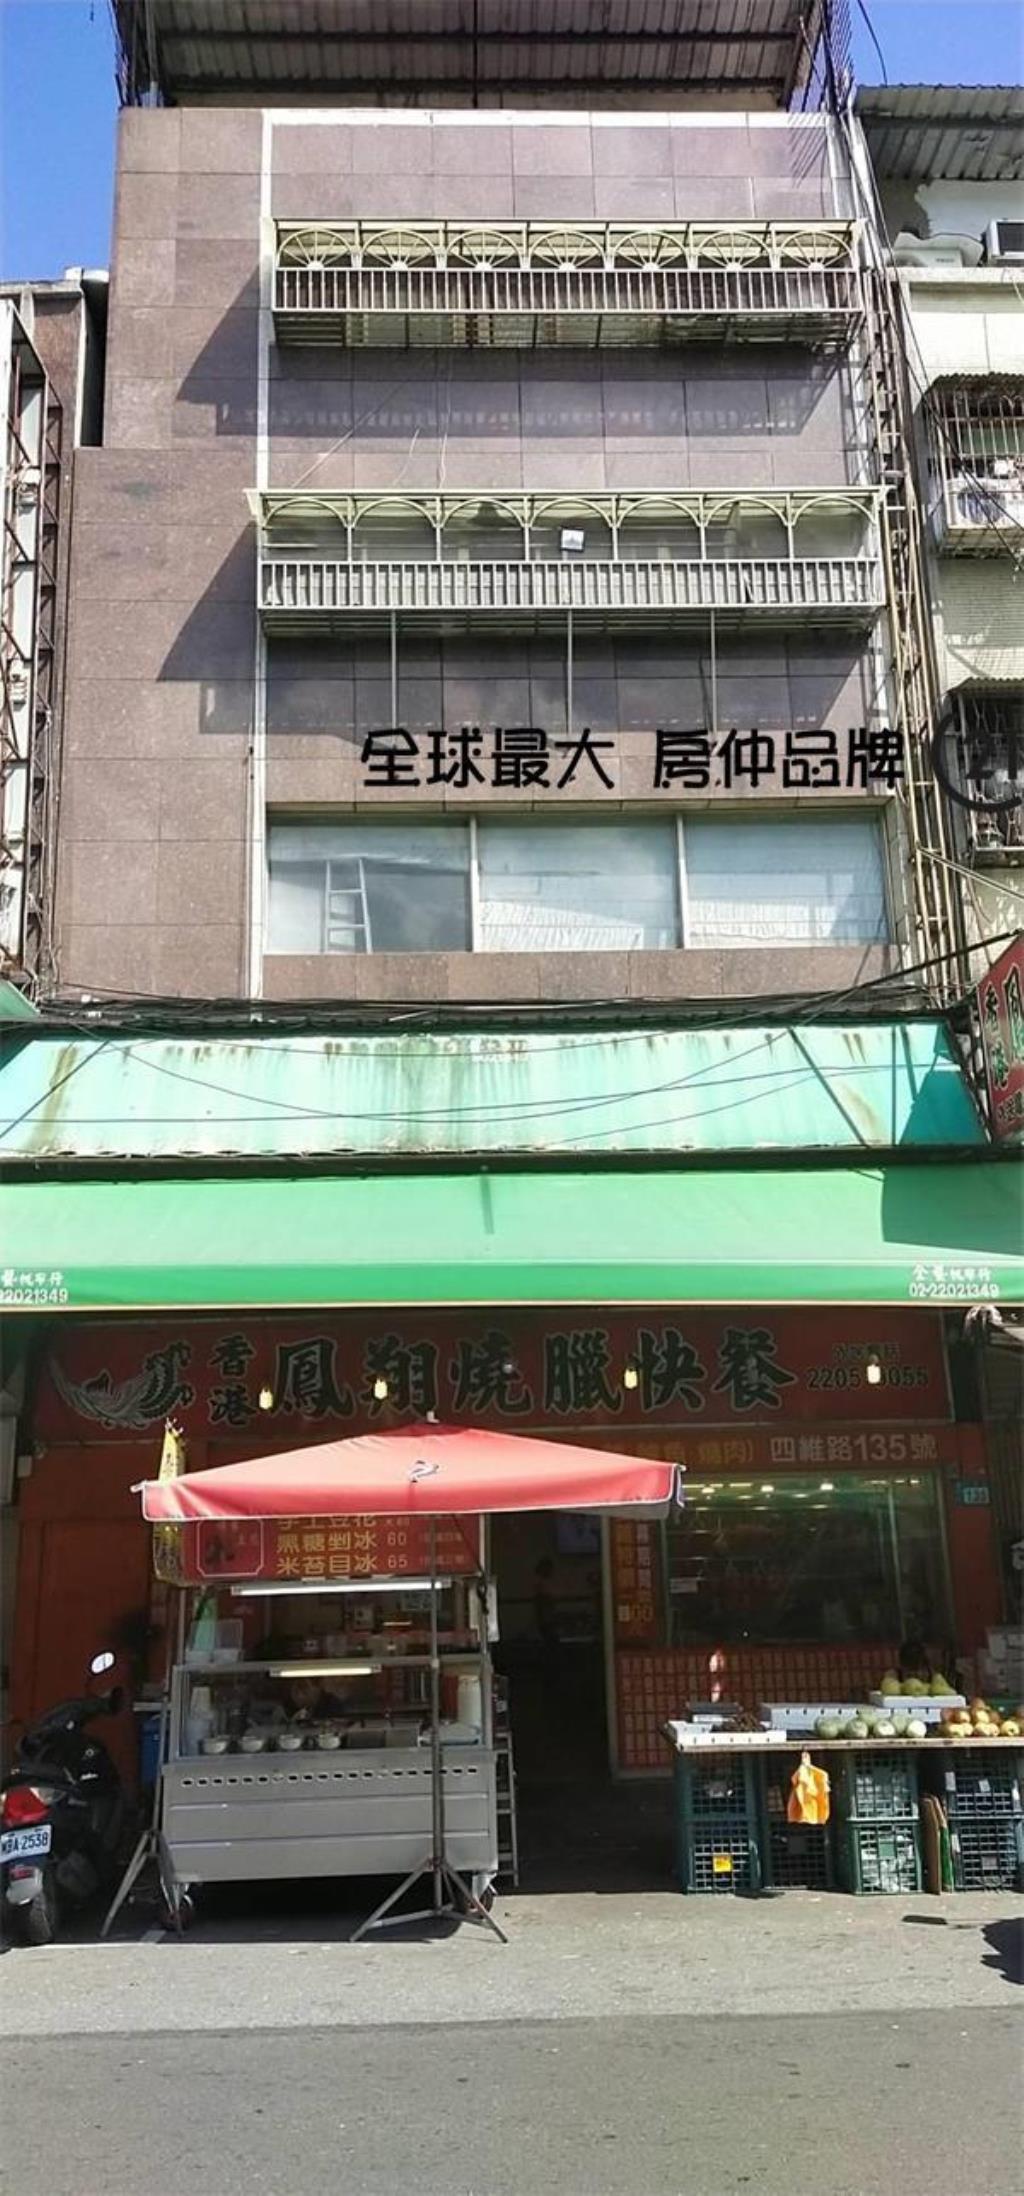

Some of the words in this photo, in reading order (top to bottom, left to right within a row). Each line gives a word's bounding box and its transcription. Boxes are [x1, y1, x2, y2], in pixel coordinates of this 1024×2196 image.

[908, 1283, 999, 1298] 02-22021349
[209, 1332, 257, 1426] 香港
[276, 1554, 378, 1576] 米苔目冰
